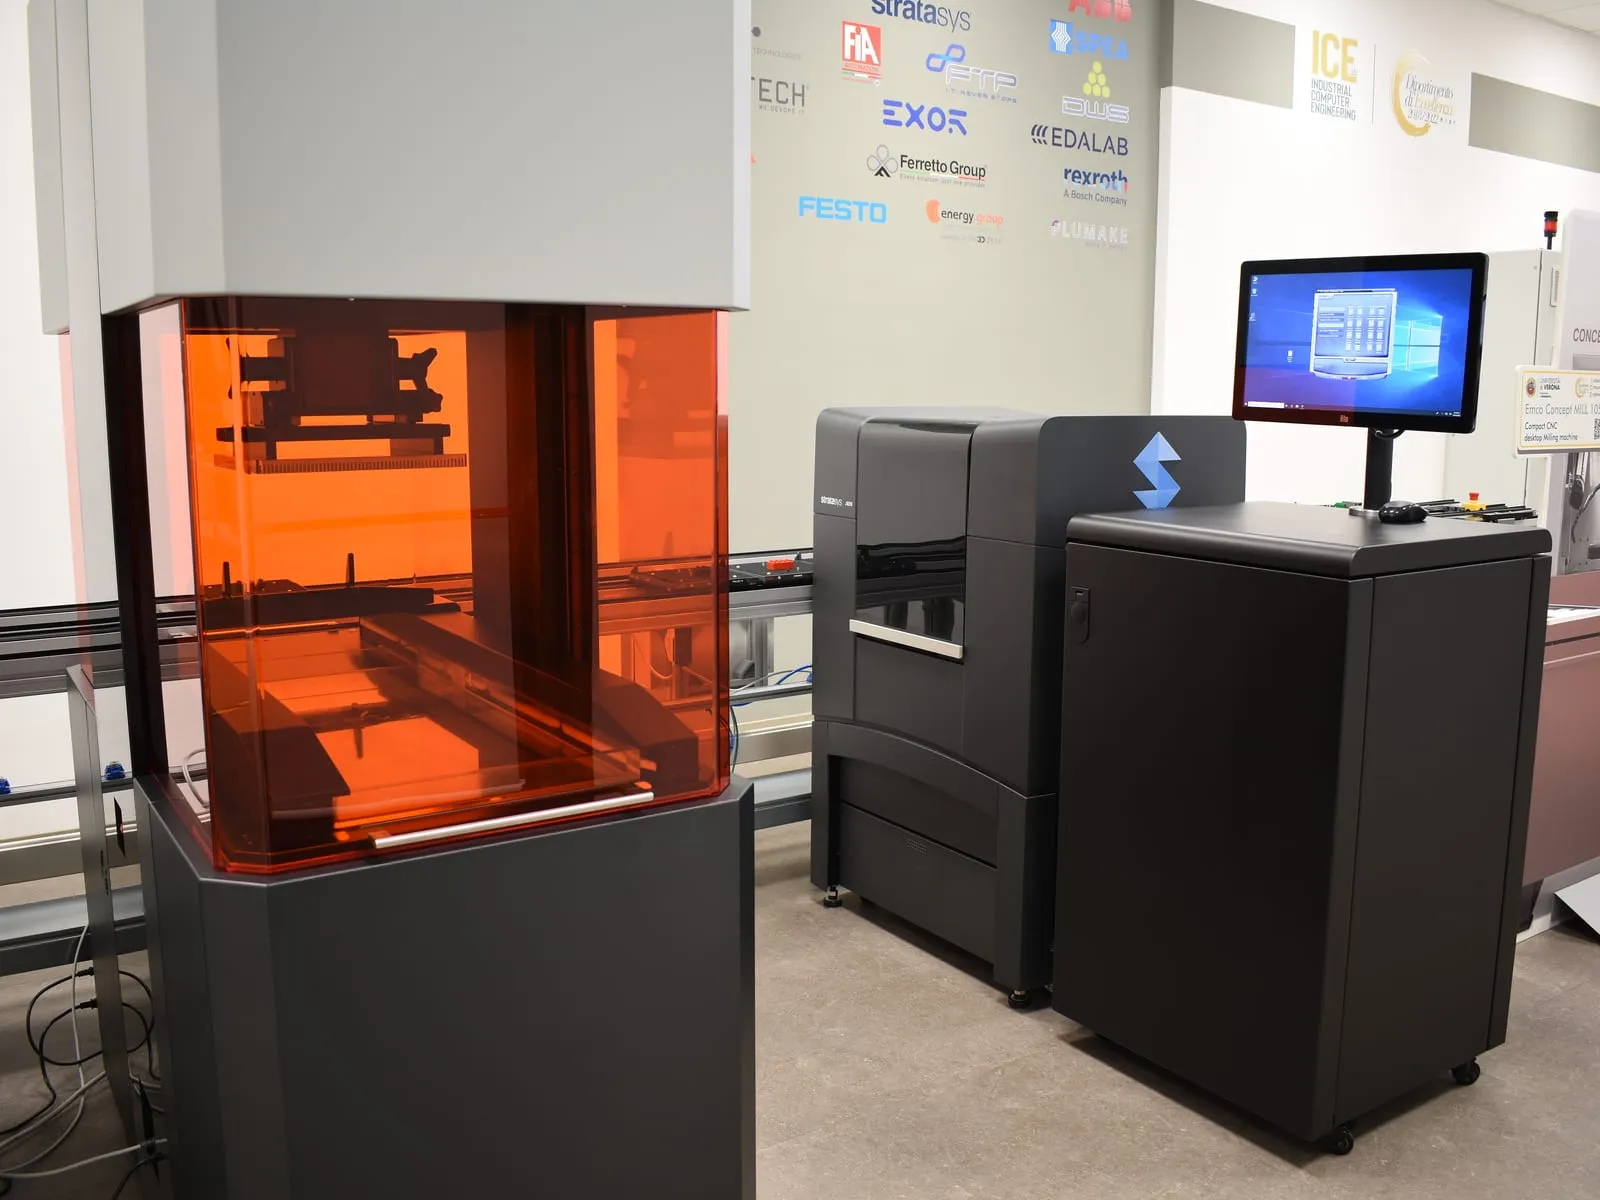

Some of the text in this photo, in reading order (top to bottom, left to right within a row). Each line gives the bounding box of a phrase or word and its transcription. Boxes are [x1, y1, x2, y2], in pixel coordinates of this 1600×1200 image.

[871, 0, 971, 33] stratasys
[1076, 29, 1130, 62] SPEA
[1312, 30, 1359, 83] ICE
[945, 64, 1017, 93] FTP
[1311, 79, 1352, 97] INDUSTRIAL
[751, 76, 805, 107] ECH
[1311, 90, 1350, 108] COMPUTER
[883, 99, 967, 136] EXOR
[1311, 102, 1356, 121] ENGINEERING
[1052, 127, 1129, 156] EDALAB
[900, 154, 986, 181] Ferretto Group
[1064, 168, 1128, 193] rexroth
[798, 195, 887, 224] FESTO
[1063, 189, 1127, 207] A Bosch Company
[941, 209, 974, 224] energy
[1051, 220, 1129, 244] PLUMAKE
[1525, 403, 1543, 415] Emco
[1545, 403, 1572, 417] Concept
[1524, 421, 1558, 431] Compact CNC
[1524, 432, 1578, 443] desktop Milling machine
